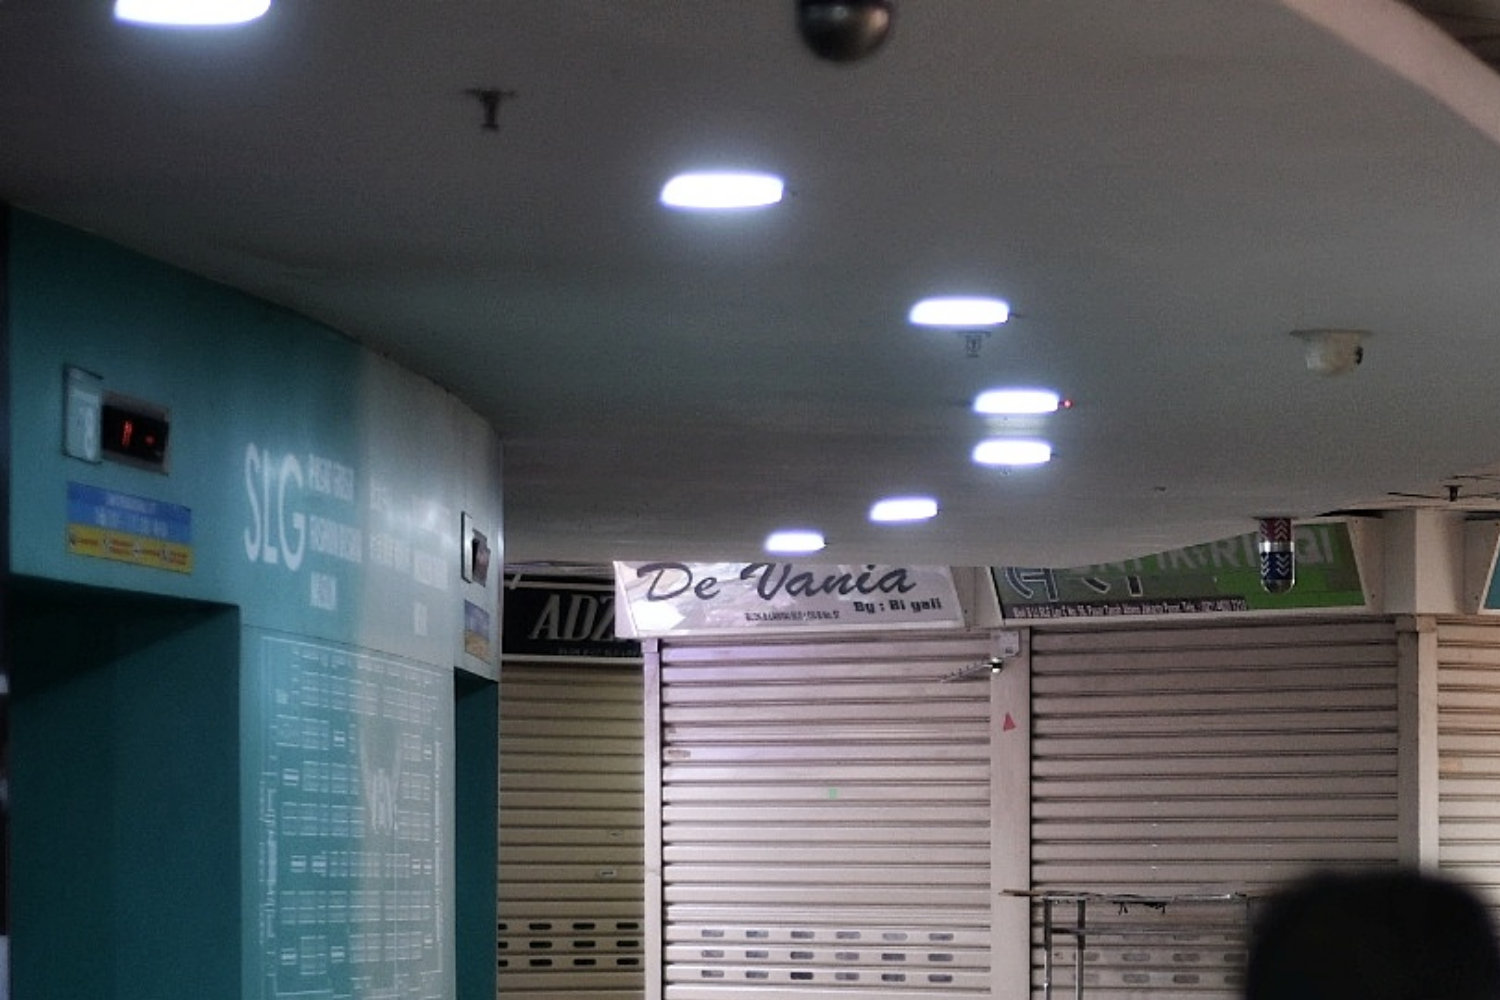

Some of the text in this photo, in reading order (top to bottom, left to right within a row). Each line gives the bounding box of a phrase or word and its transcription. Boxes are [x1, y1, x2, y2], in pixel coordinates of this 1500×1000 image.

[243, 441, 307, 572] SLG
[636, 563, 917, 602] De Vania
[853, 601, 876, 614] By
